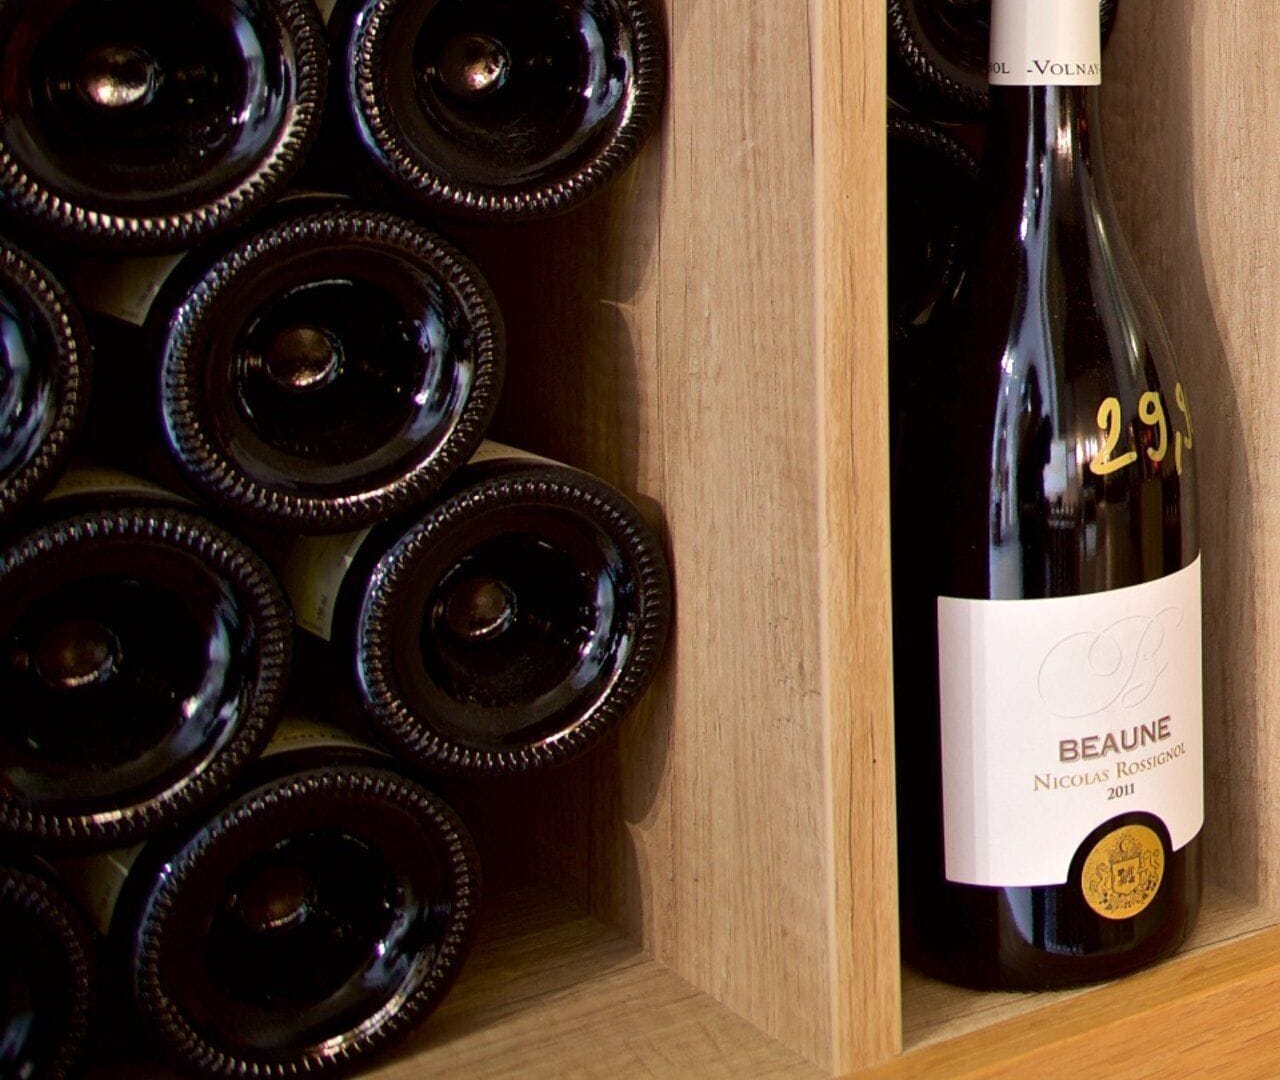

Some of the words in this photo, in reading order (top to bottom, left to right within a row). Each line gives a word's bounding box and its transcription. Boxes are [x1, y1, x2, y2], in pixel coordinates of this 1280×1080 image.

[1059, 715, 1172, 764] BEAUNE
[1032, 768, 1110, 793] NICOLAS
[1116, 742, 1187, 780] ROSSIGNOL
[1107, 783, 1136, 802] 2011
